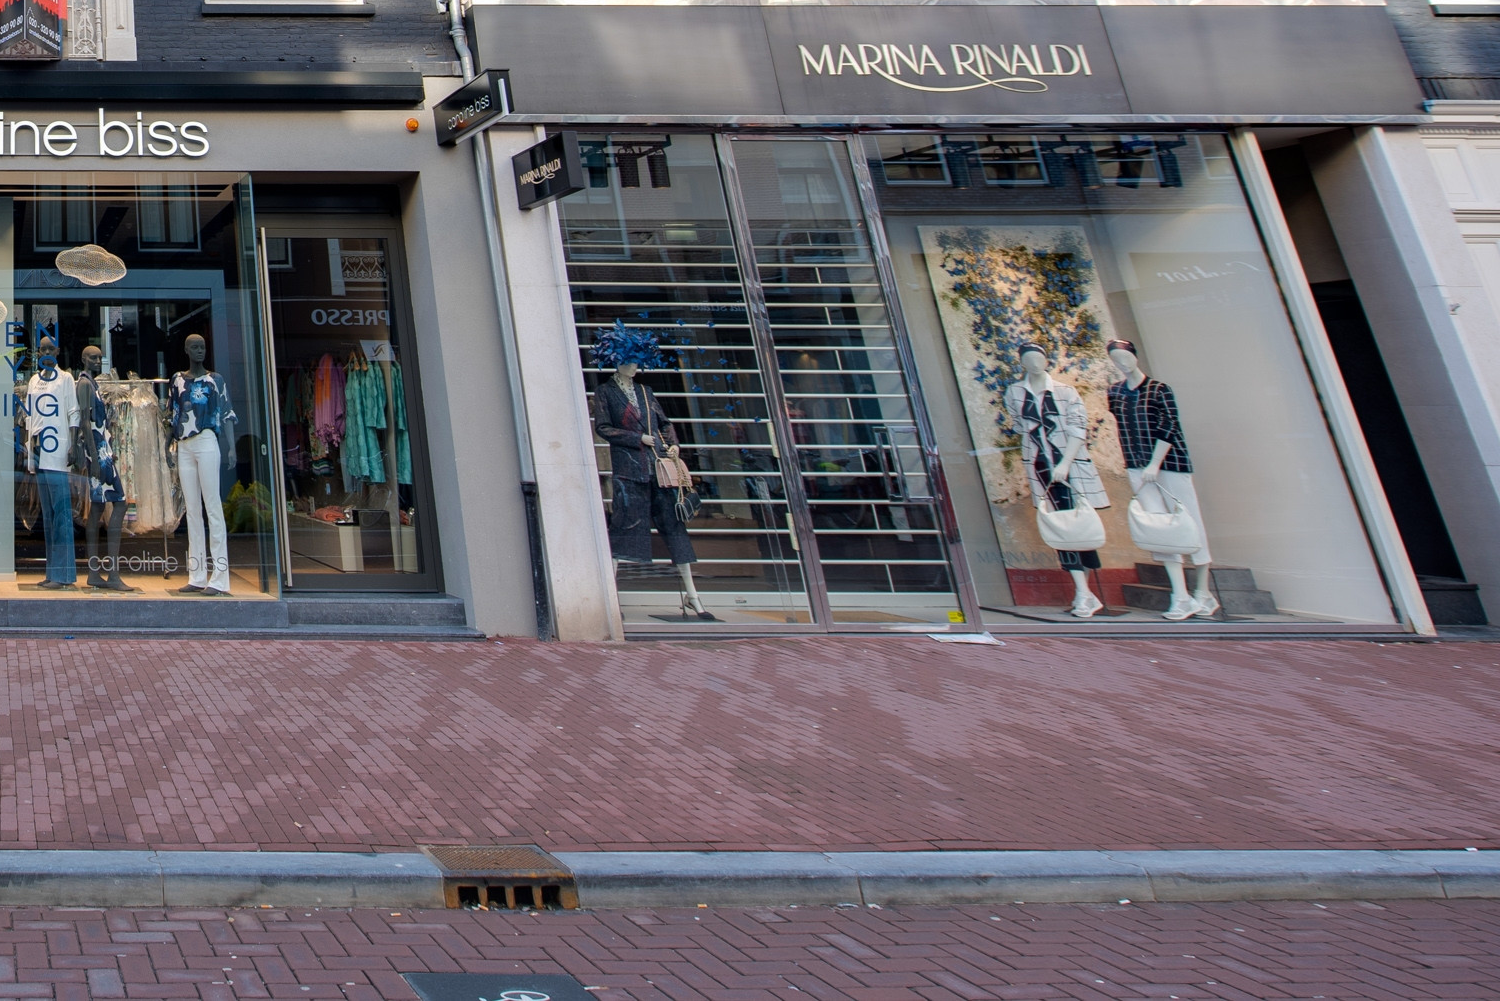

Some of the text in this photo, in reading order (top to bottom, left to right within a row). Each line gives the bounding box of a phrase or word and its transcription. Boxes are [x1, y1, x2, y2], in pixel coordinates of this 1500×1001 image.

[10, 19, 16, 29] 90
[17, 15, 23, 25] 80
[798, 43, 1092, 86] MARINA RINALDI
[448, 93, 490, 130] caroline biss
[97, 107, 211, 157] biss
[520, 158, 562, 184] MARINA RINALDI
[87, 550, 230, 572] caroline biss
